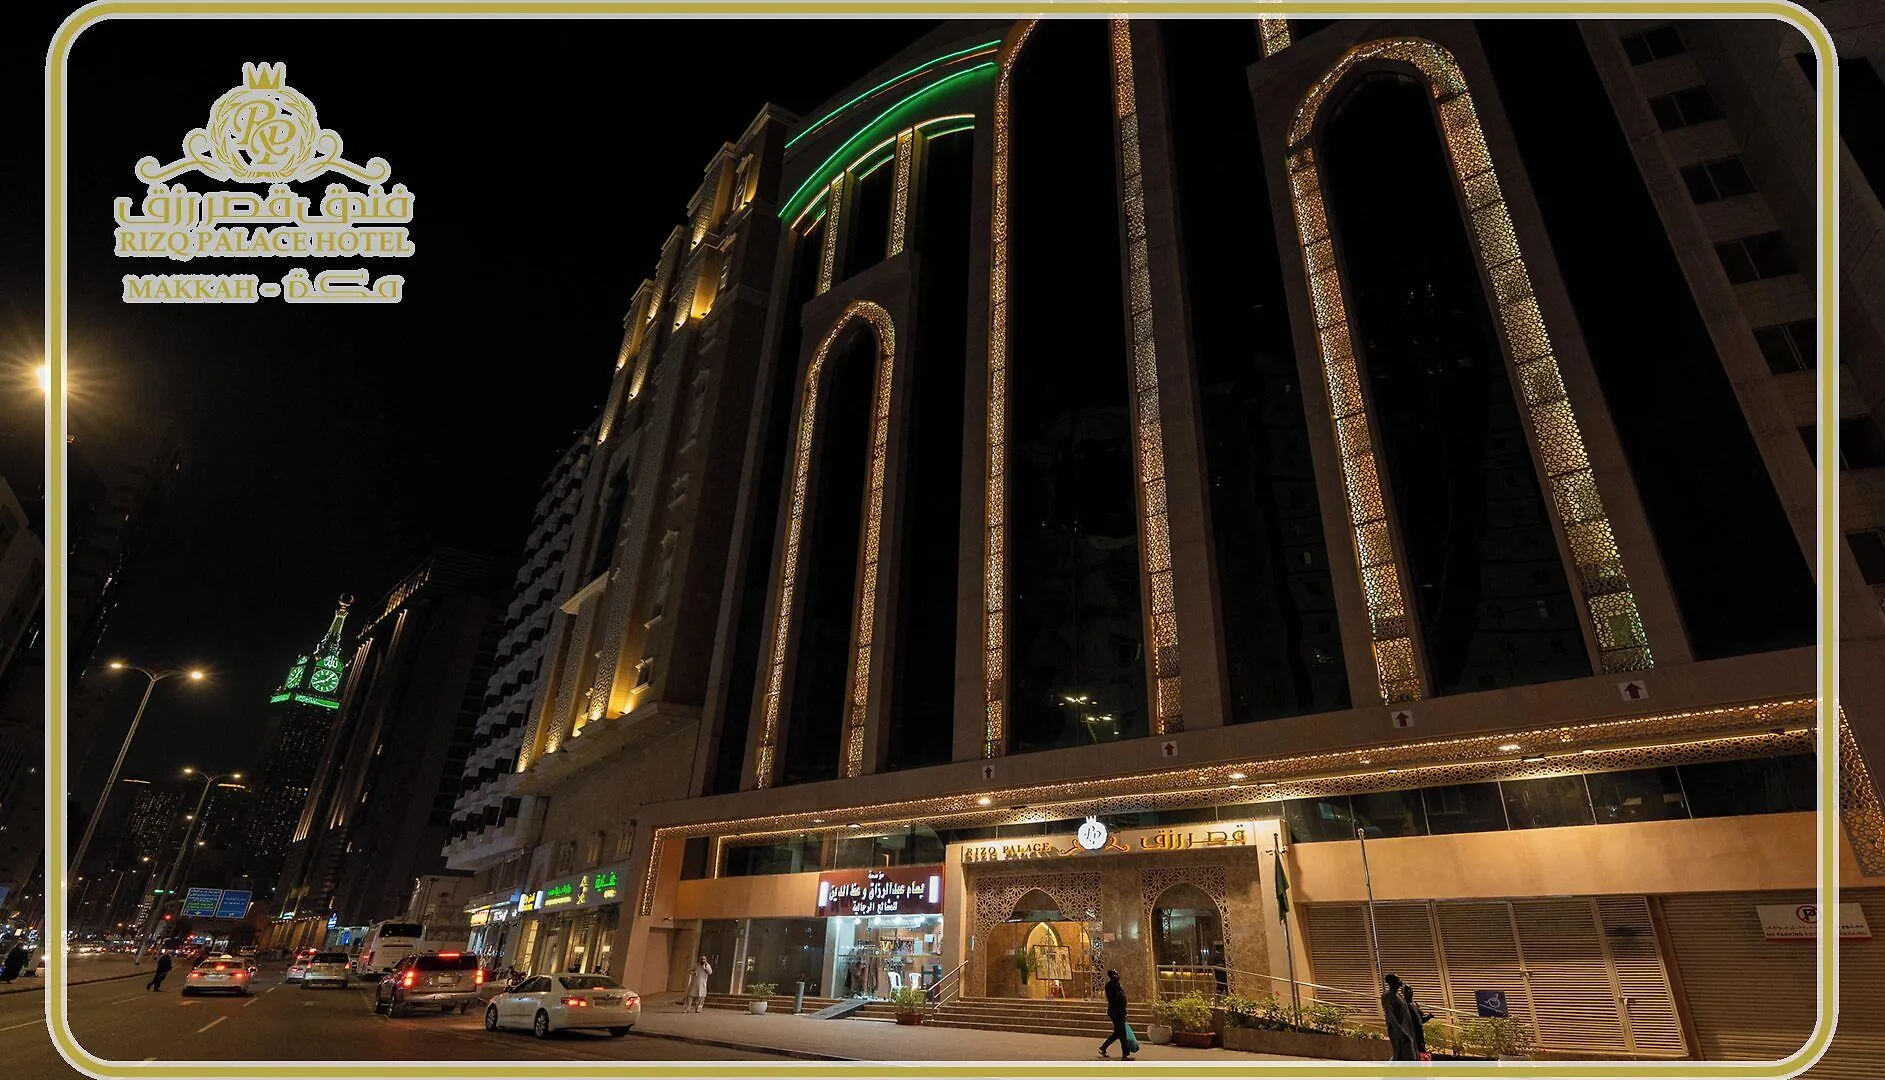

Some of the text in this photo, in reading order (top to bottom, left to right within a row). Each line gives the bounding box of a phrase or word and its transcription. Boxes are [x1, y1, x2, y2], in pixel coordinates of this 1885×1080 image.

[1140, 823, 1247, 849] قصر رزق
[965, 842, 1051, 858] RIZQ PALACE
[907, 880, 926, 899] بسام
